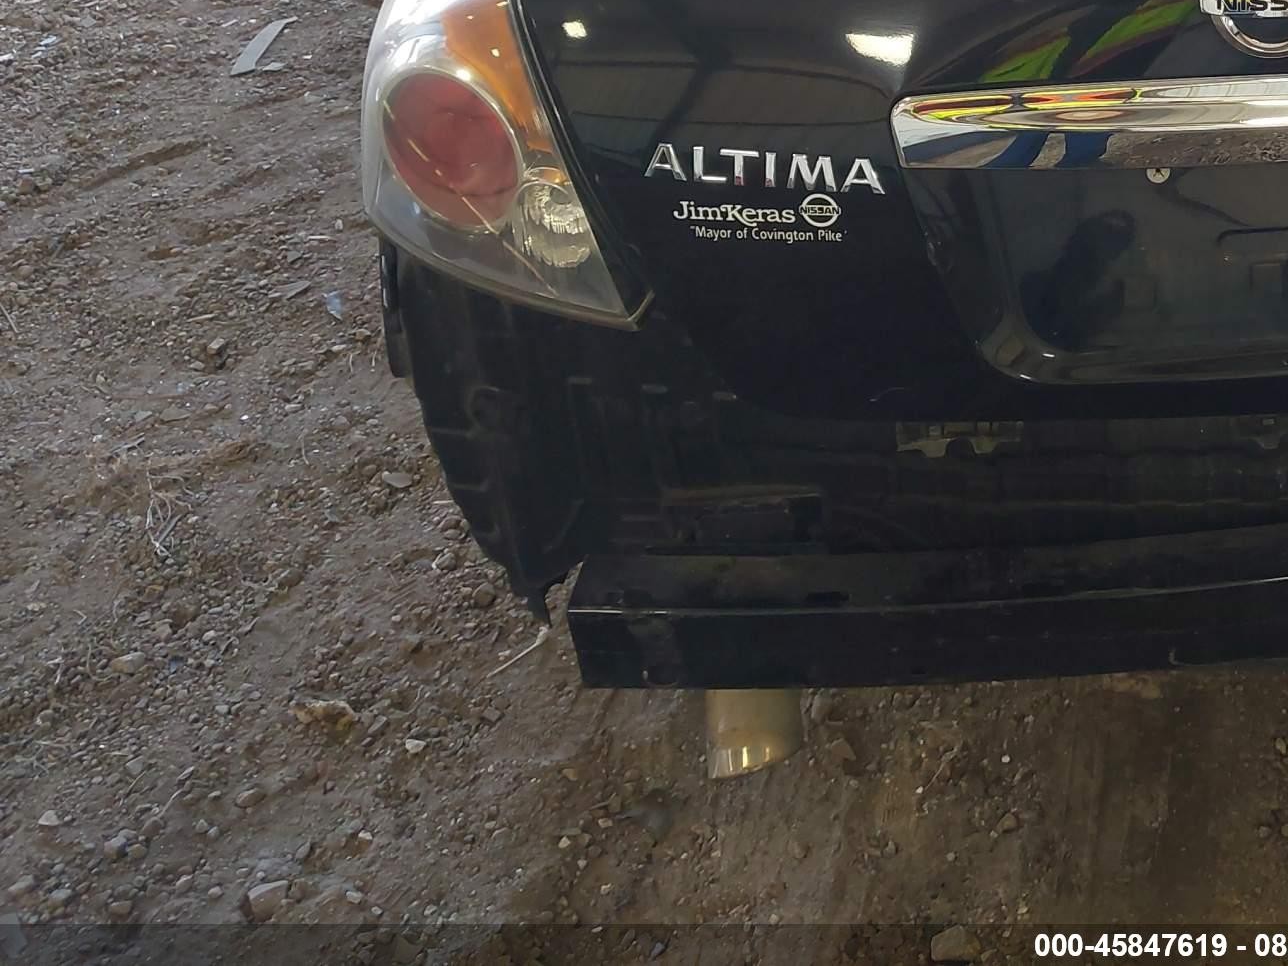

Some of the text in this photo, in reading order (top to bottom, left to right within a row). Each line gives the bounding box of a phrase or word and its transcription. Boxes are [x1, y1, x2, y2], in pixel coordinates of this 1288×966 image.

[644, 143, 886, 195] ALTIMA
[736, 227, 748, 240] of
[751, 228, 814, 244] Covington
